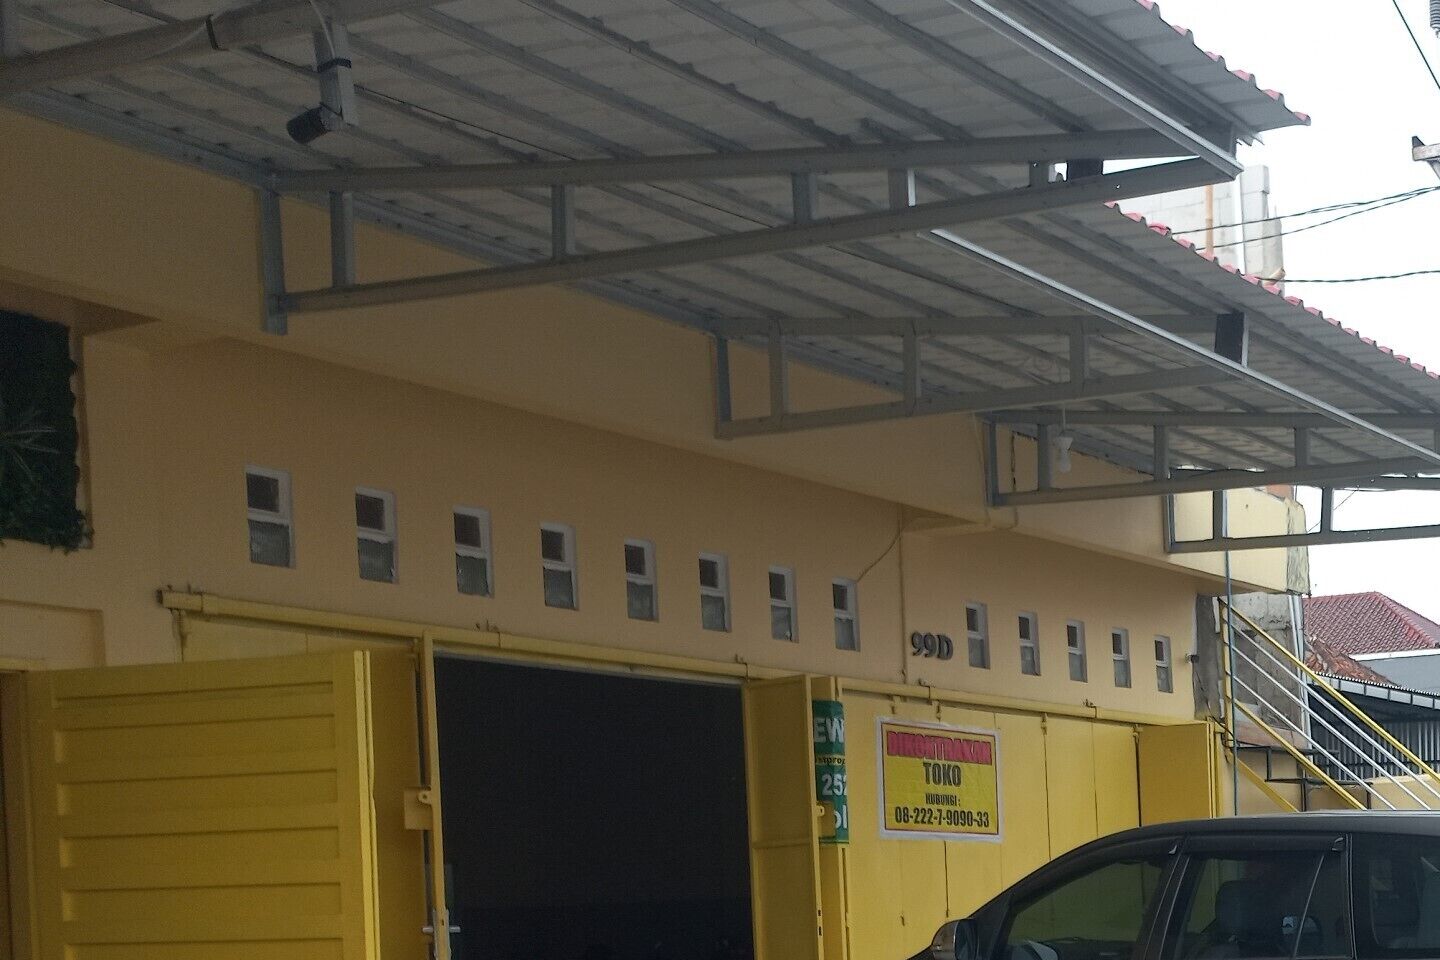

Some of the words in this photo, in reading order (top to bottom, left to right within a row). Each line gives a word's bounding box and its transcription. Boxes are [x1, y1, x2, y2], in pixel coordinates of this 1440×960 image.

[911, 631, 954, 661] 99D
[922, 760, 963, 788] TOKO
[894, 805, 991, 828] 08-222-7-9090-33
